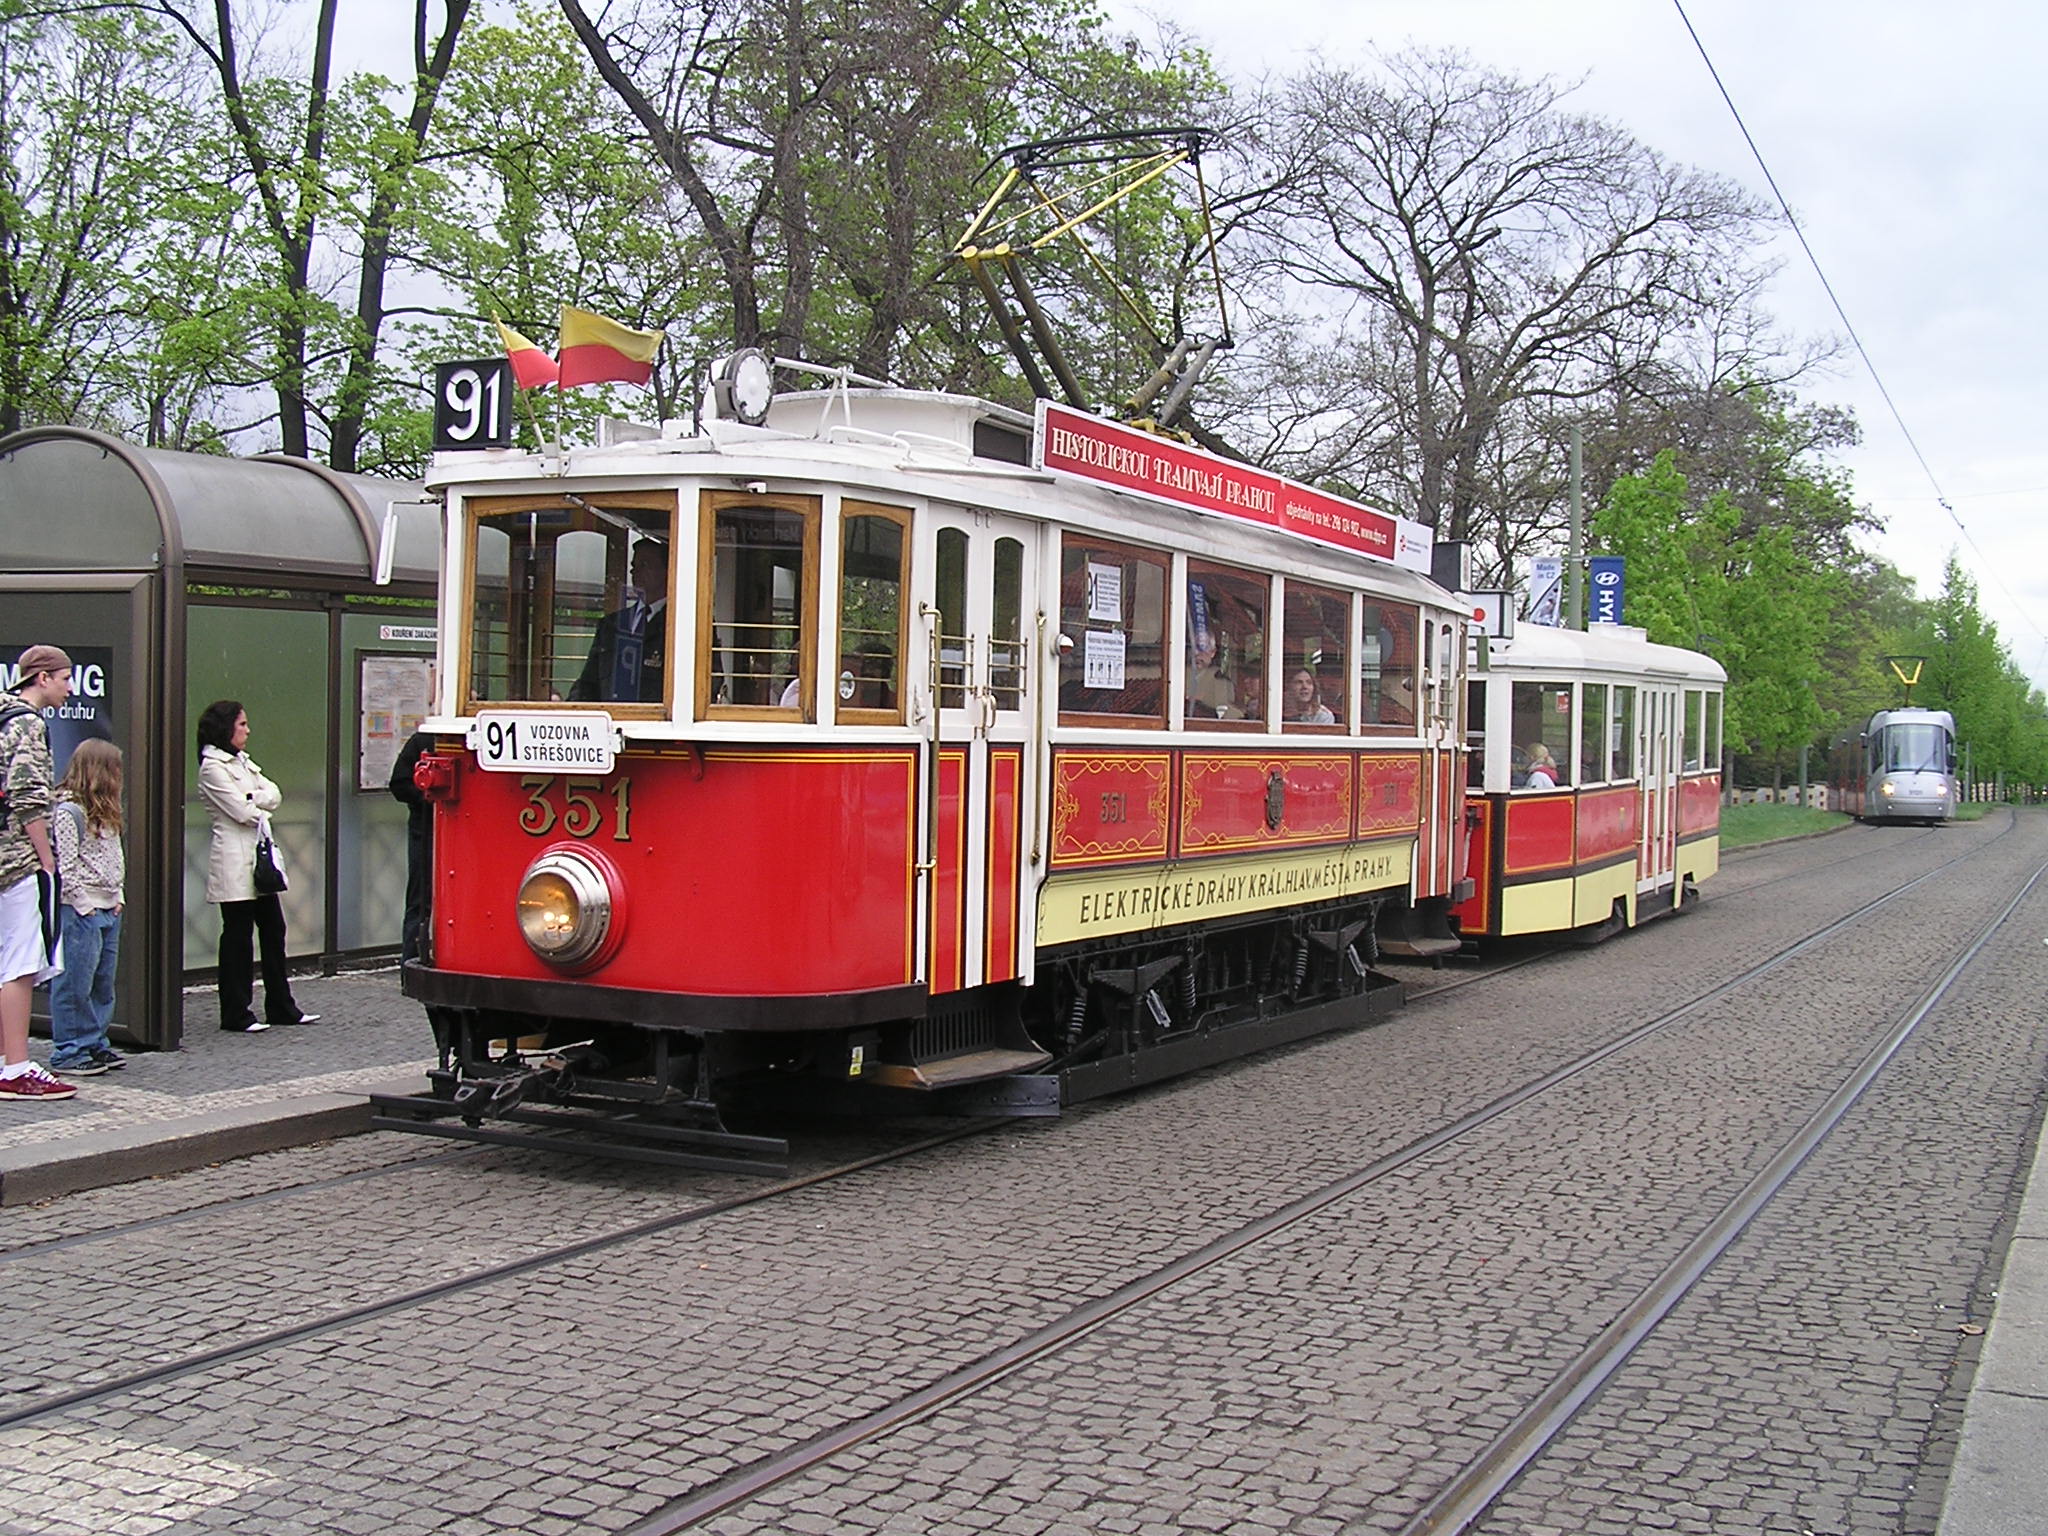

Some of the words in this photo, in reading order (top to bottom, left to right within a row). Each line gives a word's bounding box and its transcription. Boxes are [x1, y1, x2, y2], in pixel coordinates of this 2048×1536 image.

[446, 368, 501, 441] 91
[1051, 427, 1150, 480] HISTORICKOU
[1153, 457, 1223, 500] TRAMVAJÍ
[1225, 479, 1275, 514] PRAHOU
[1536, 563, 1555, 571] Made
[414, 629, 438, 639] ZAKÁZÁN
[0, 663, 105, 697] MNG
[58, 701, 95, 720] druhu
[487, 721, 518, 761] 91
[530, 725, 590, 741] VOZOVNA
[524, 743, 604, 763] STŘEŠOVICE
[519, 775, 632, 842] 351
[1100, 792, 1127, 824] 351
[1080, 877, 1193, 924] ELEKTRICKÉ
[1196, 873, 1246, 906] DRÁHY
